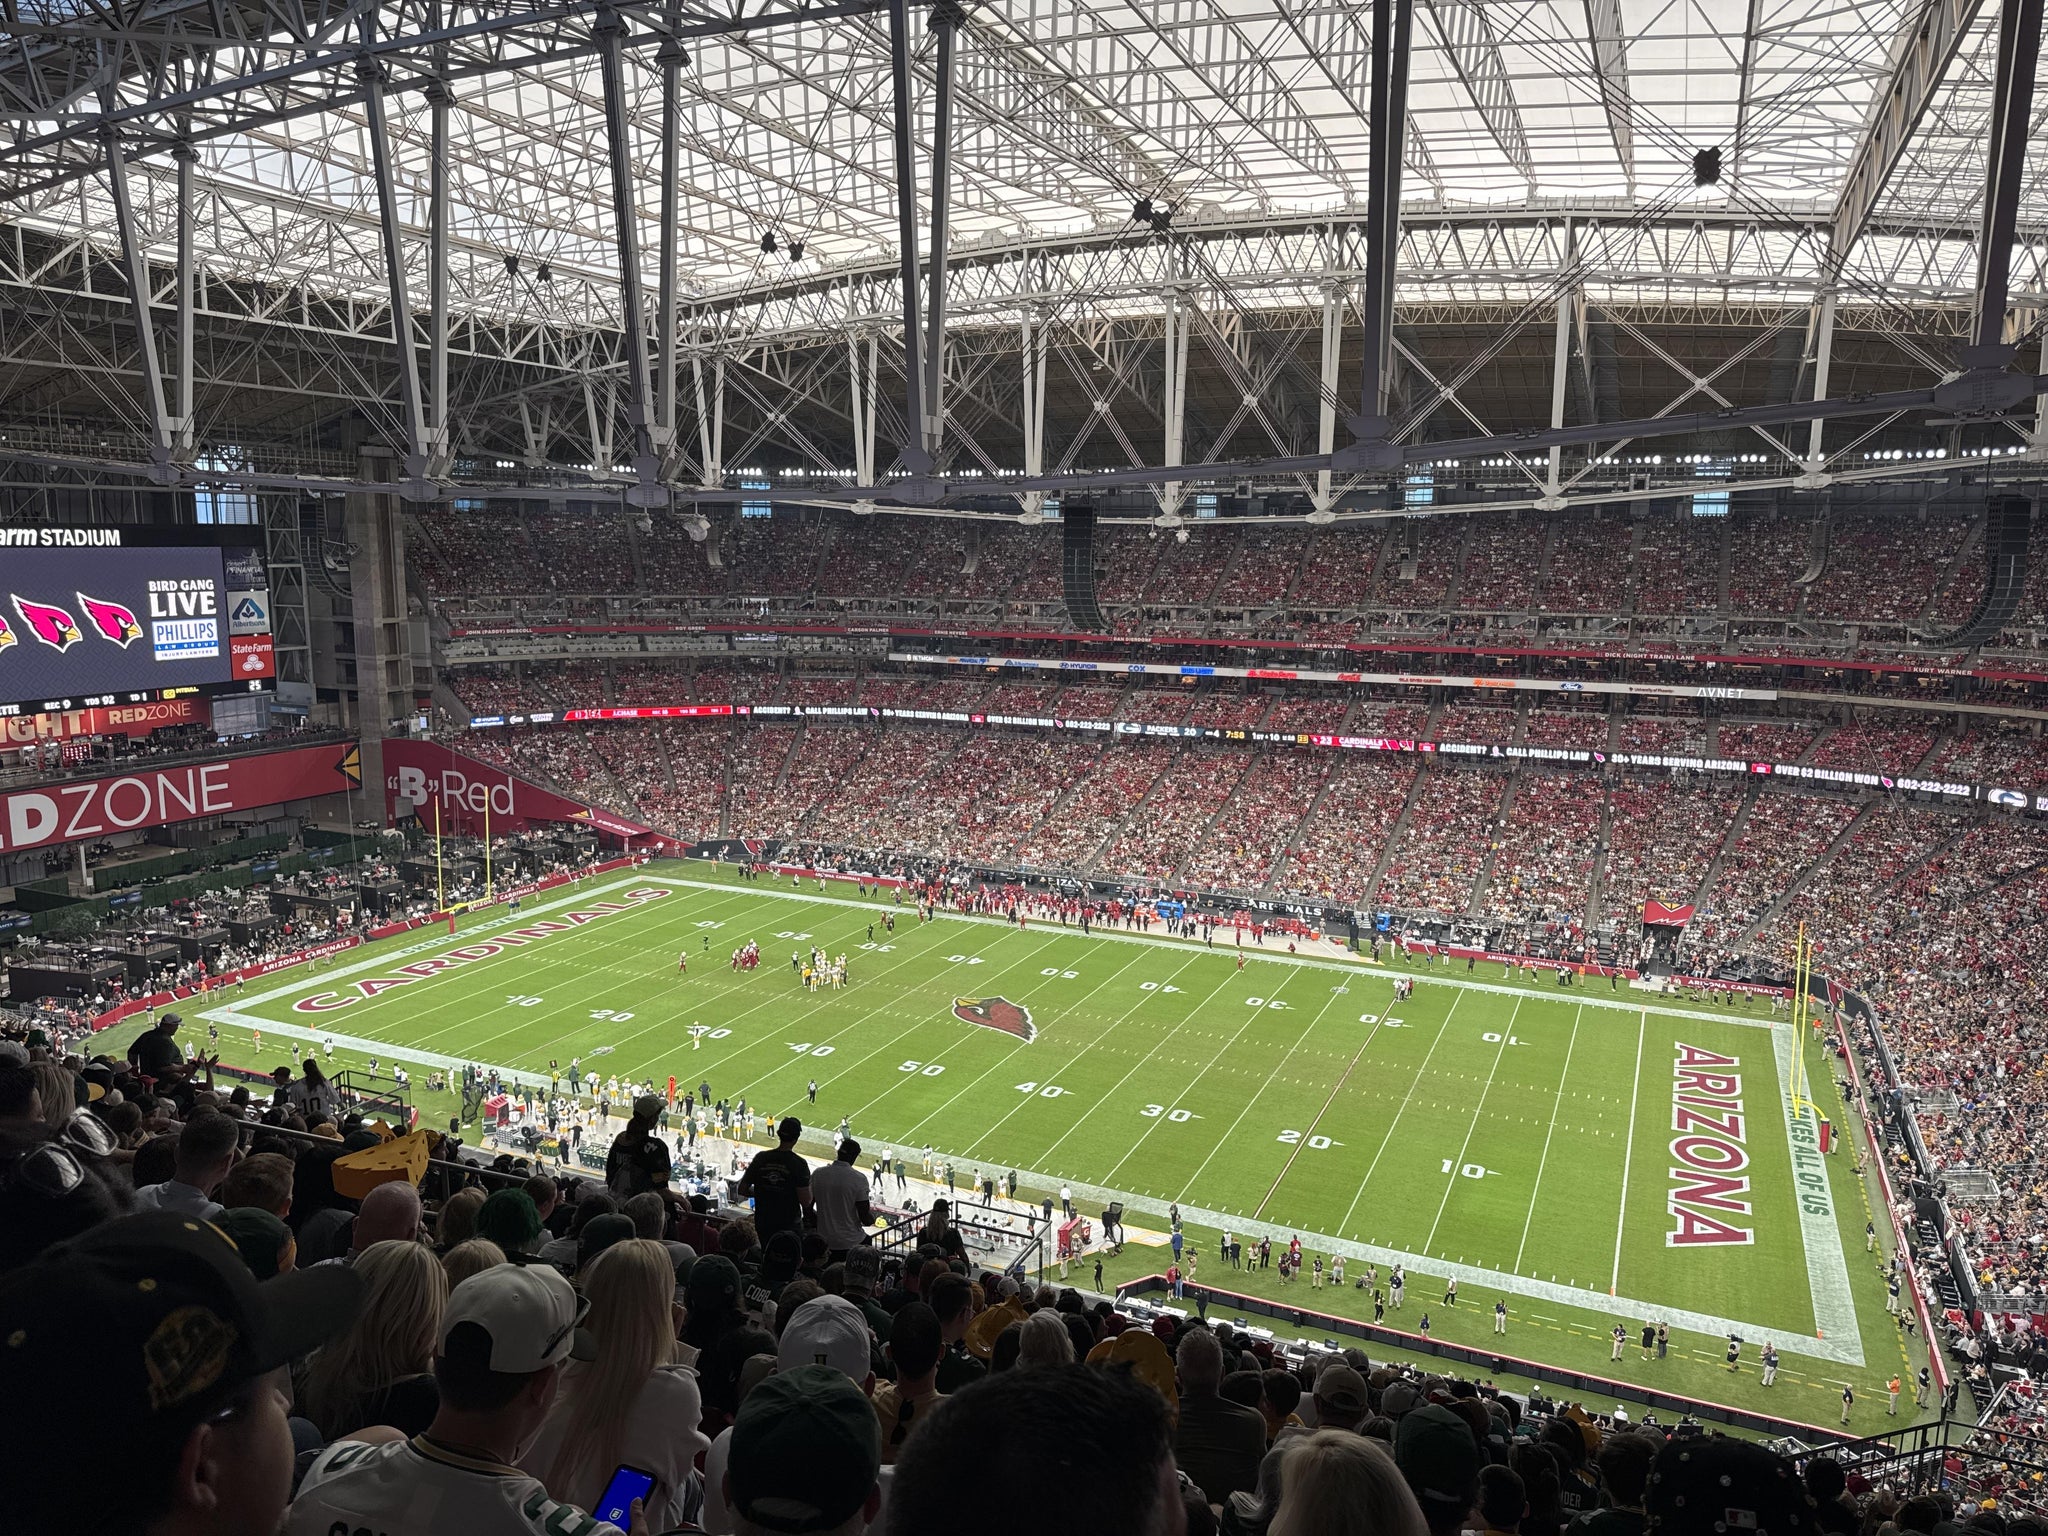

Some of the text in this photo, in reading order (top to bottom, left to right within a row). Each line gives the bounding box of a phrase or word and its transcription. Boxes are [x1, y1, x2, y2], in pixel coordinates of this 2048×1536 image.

[40, 528, 121, 546] STADIUM
[148, 579, 215, 592] BIRD GANG
[149, 591, 217, 617] LIVE
[156, 622, 214, 641] PHILLIPS
[232, 620, 266, 629] Albertsons
[232, 643, 272, 654] State Farm
[1622, 652, 1648, 660] (NIGHT
[1937, 668, 1973, 676] WARNER
[1697, 687, 1744, 699] AVNET
[63, 699, 72, 709] 9
[102, 695, 115, 705] 92
[108, 702, 192, 726] REDZONE
[753, 706, 791, 714] ACCIDENT?
[805, 707, 822, 715] CALL
[895, 709, 914, 717] YEARS
[942, 713, 969, 721] ARIZONA
[1146, 724, 1178, 733] PACKERS
[1184, 727, 1197, 736] 20
[1225, 730, 1245, 739] 7:58
[1319, 736, 1383, 746] 23 CARDINALS
[1439, 743, 1971, 796] ACCIDENT? CALL PHILLIPS LAW 30+ YEARS SERVING ARIZONA OVER $2 BILLION WON 602-222-2222
[0, 763, 233, 848] DZONE
[499, 886, 536, 901] CARDINALS
[261, 939, 353, 973] ARIZONA CARDINALS
[291, 887, 674, 1013] CARDINALS
[1040, 967, 1080, 980] 50
[788, 1042, 836, 1057] 40
[897, 1060, 946, 1077] 50
[1014, 1081, 1065, 1098] 40
[1139, 1104, 1193, 1123] 30
[1276, 1129, 1333, 1149] 20
[1665, 1041, 1755, 1248] ARIZONA
[1793, 1144, 1821, 1169] ALL
[1441, 1158, 1486, 1179] 10
[1798, 1171, 1826, 1193] OF
[1801, 1194, 1831, 1217] US
